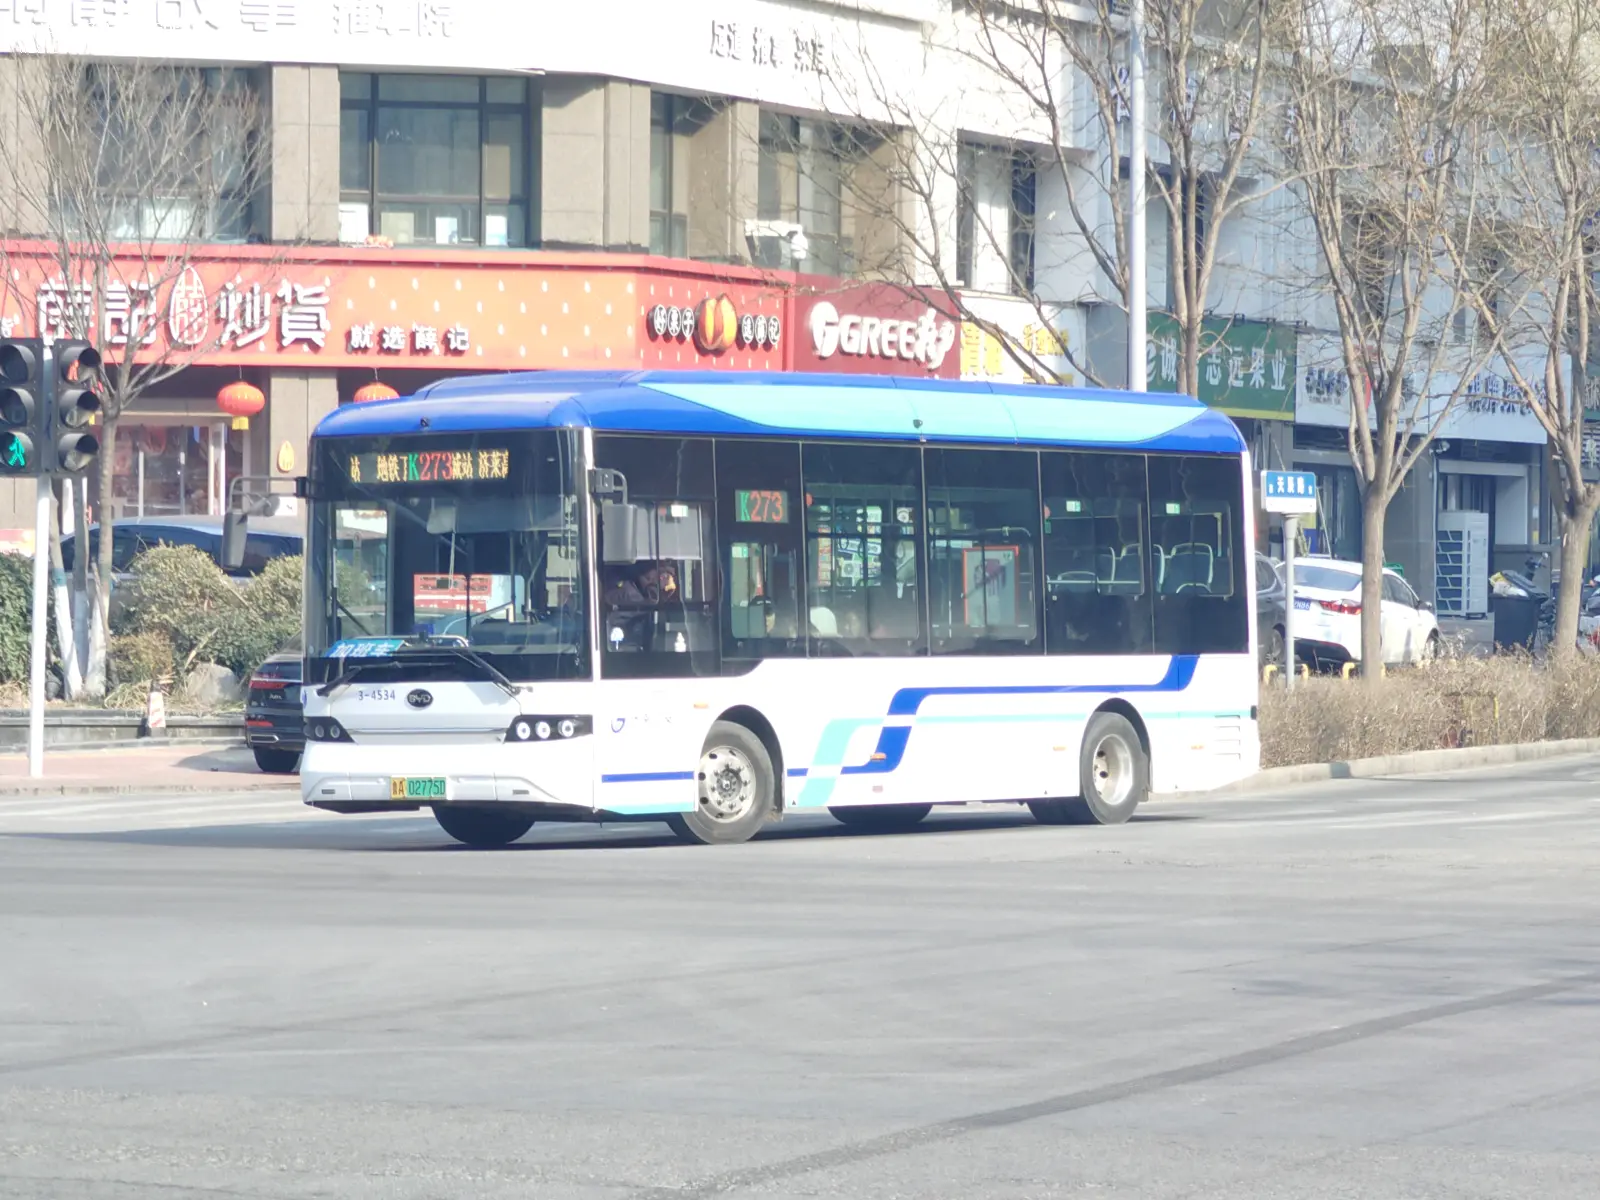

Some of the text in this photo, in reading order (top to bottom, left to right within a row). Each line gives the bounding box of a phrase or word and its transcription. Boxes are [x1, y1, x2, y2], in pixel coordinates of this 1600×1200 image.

[838, 314, 917, 360] GREE
[408, 452, 453, 481] K273
[740, 490, 783, 522] K273
[358, 690, 396, 701] 3-4534
